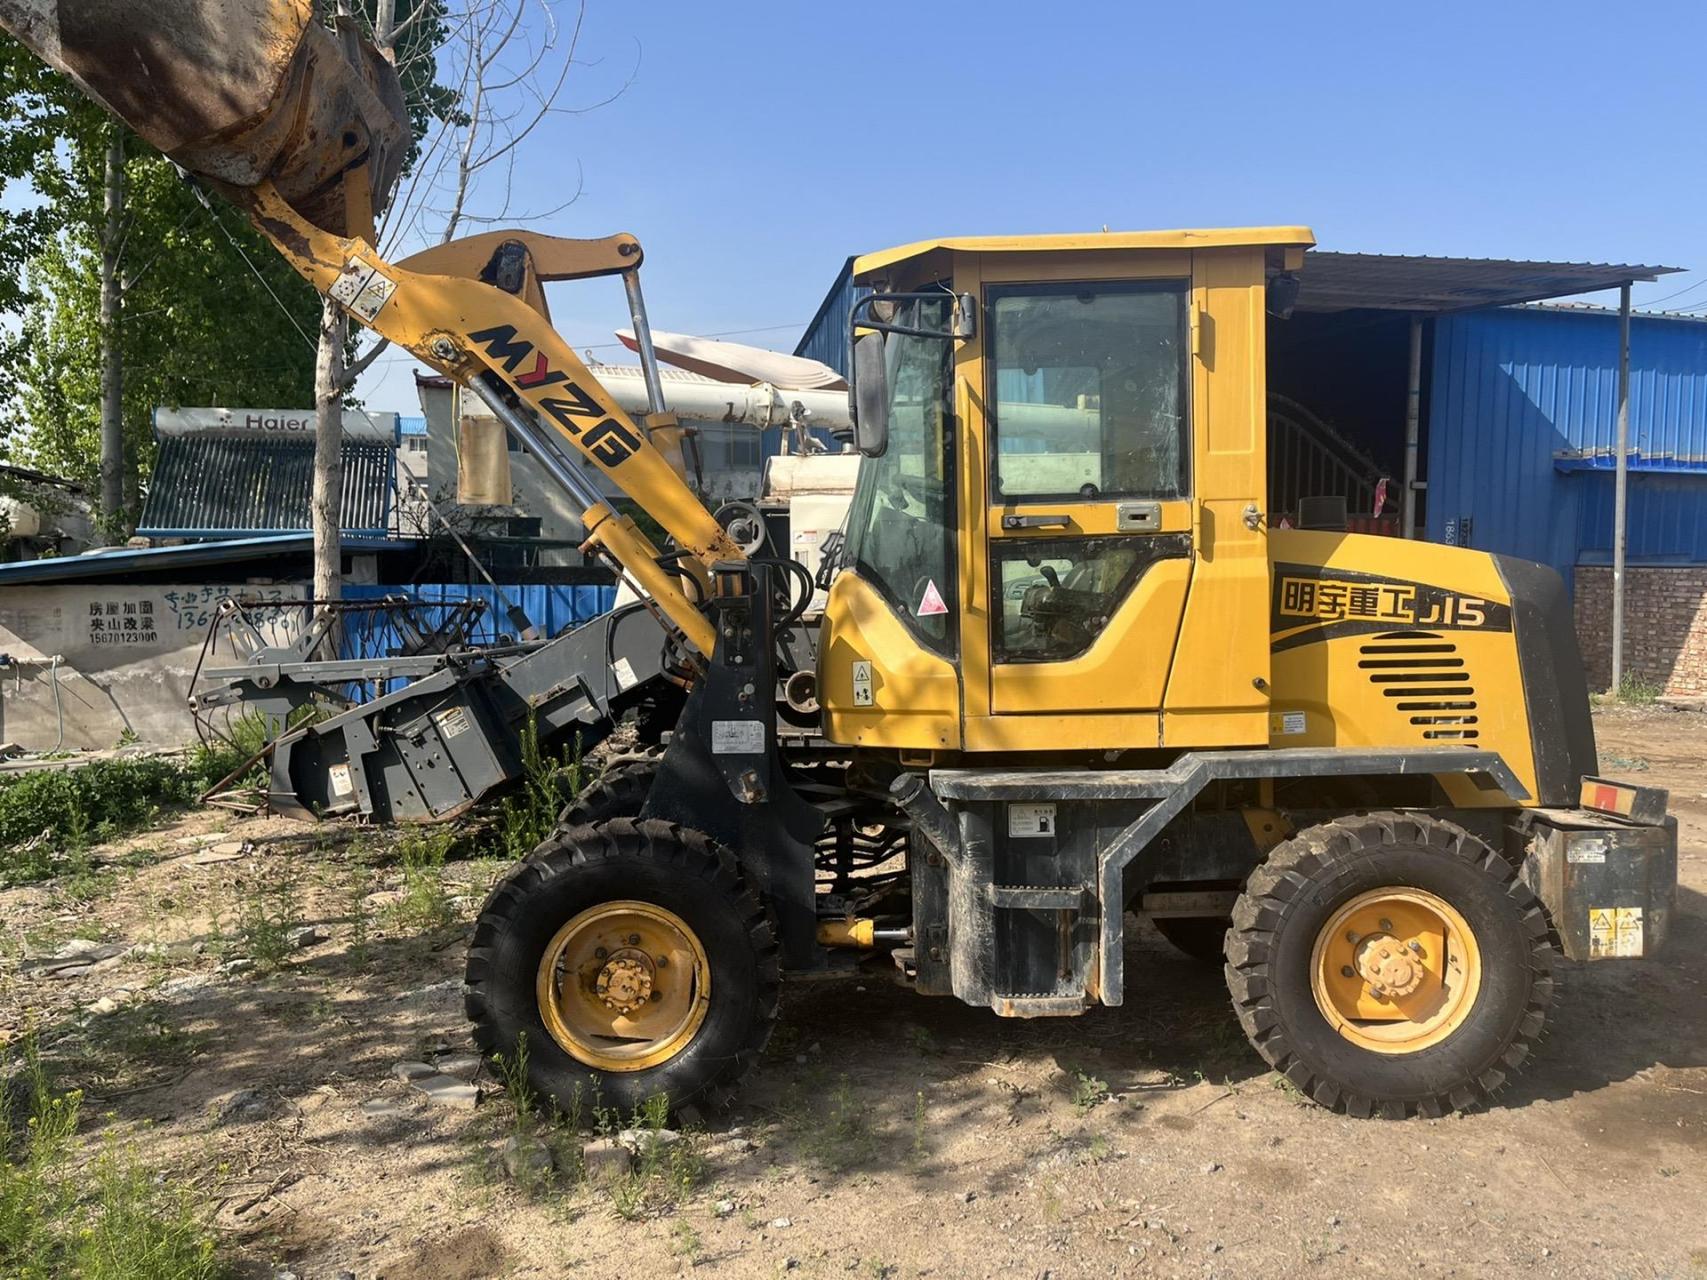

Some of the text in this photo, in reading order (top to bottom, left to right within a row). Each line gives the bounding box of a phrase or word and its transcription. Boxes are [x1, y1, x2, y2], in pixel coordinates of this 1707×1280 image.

[467, 324, 642, 468] MYZG
[246, 415, 308, 430] Haier
[1281, 577, 1416, 624] 明宇重工
